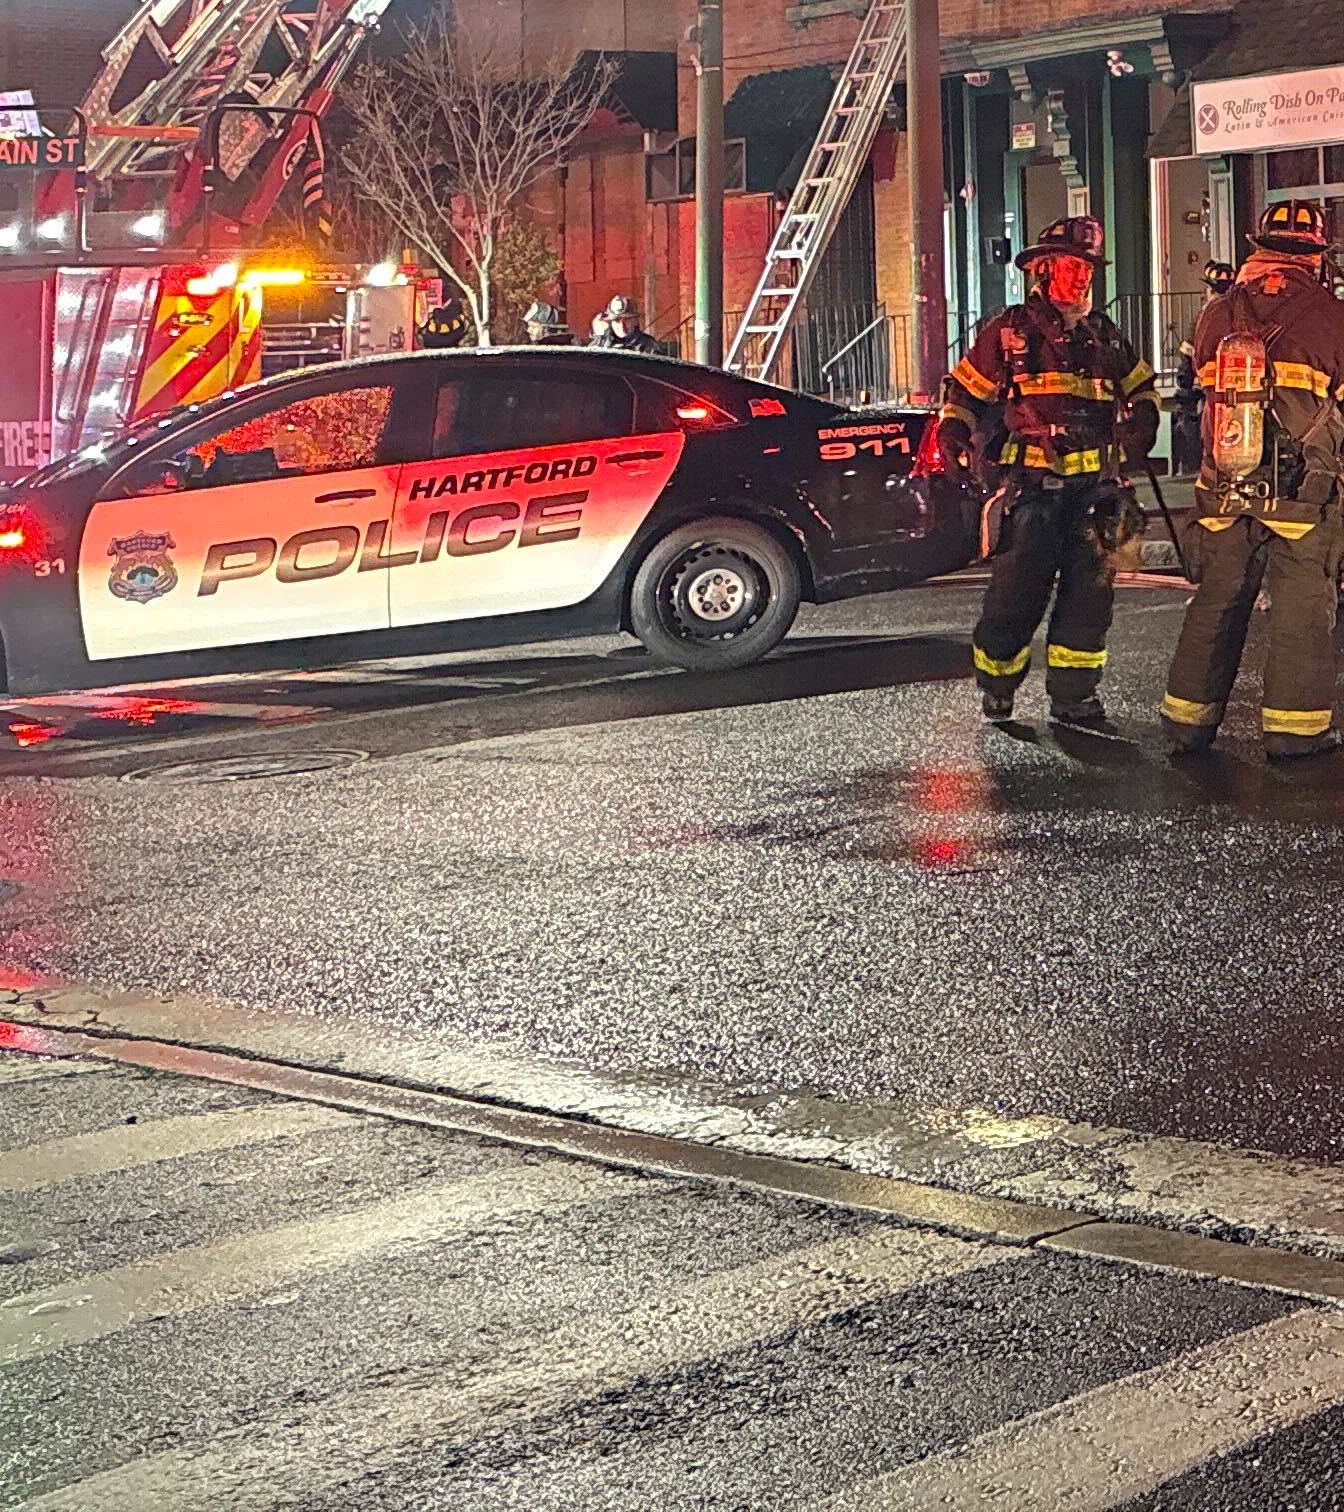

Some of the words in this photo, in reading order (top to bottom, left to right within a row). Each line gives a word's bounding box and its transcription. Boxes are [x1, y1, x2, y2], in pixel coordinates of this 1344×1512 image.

[1223, 97, 1267, 120] Rolling
[1269, 90, 1302, 110] Dish
[1305, 90, 1323, 106] On
[1224, 121, 1250, 134] Latin
[1267, 115, 1318, 127] American
[46, 138, 80, 163] ST
[817, 423, 906, 440] EMERGENCY
[820, 436, 911, 460] 911
[409, 455, 598, 502] HARTFORD
[197, 490, 590, 597] POLICE
[34, 557, 65, 577] 31
